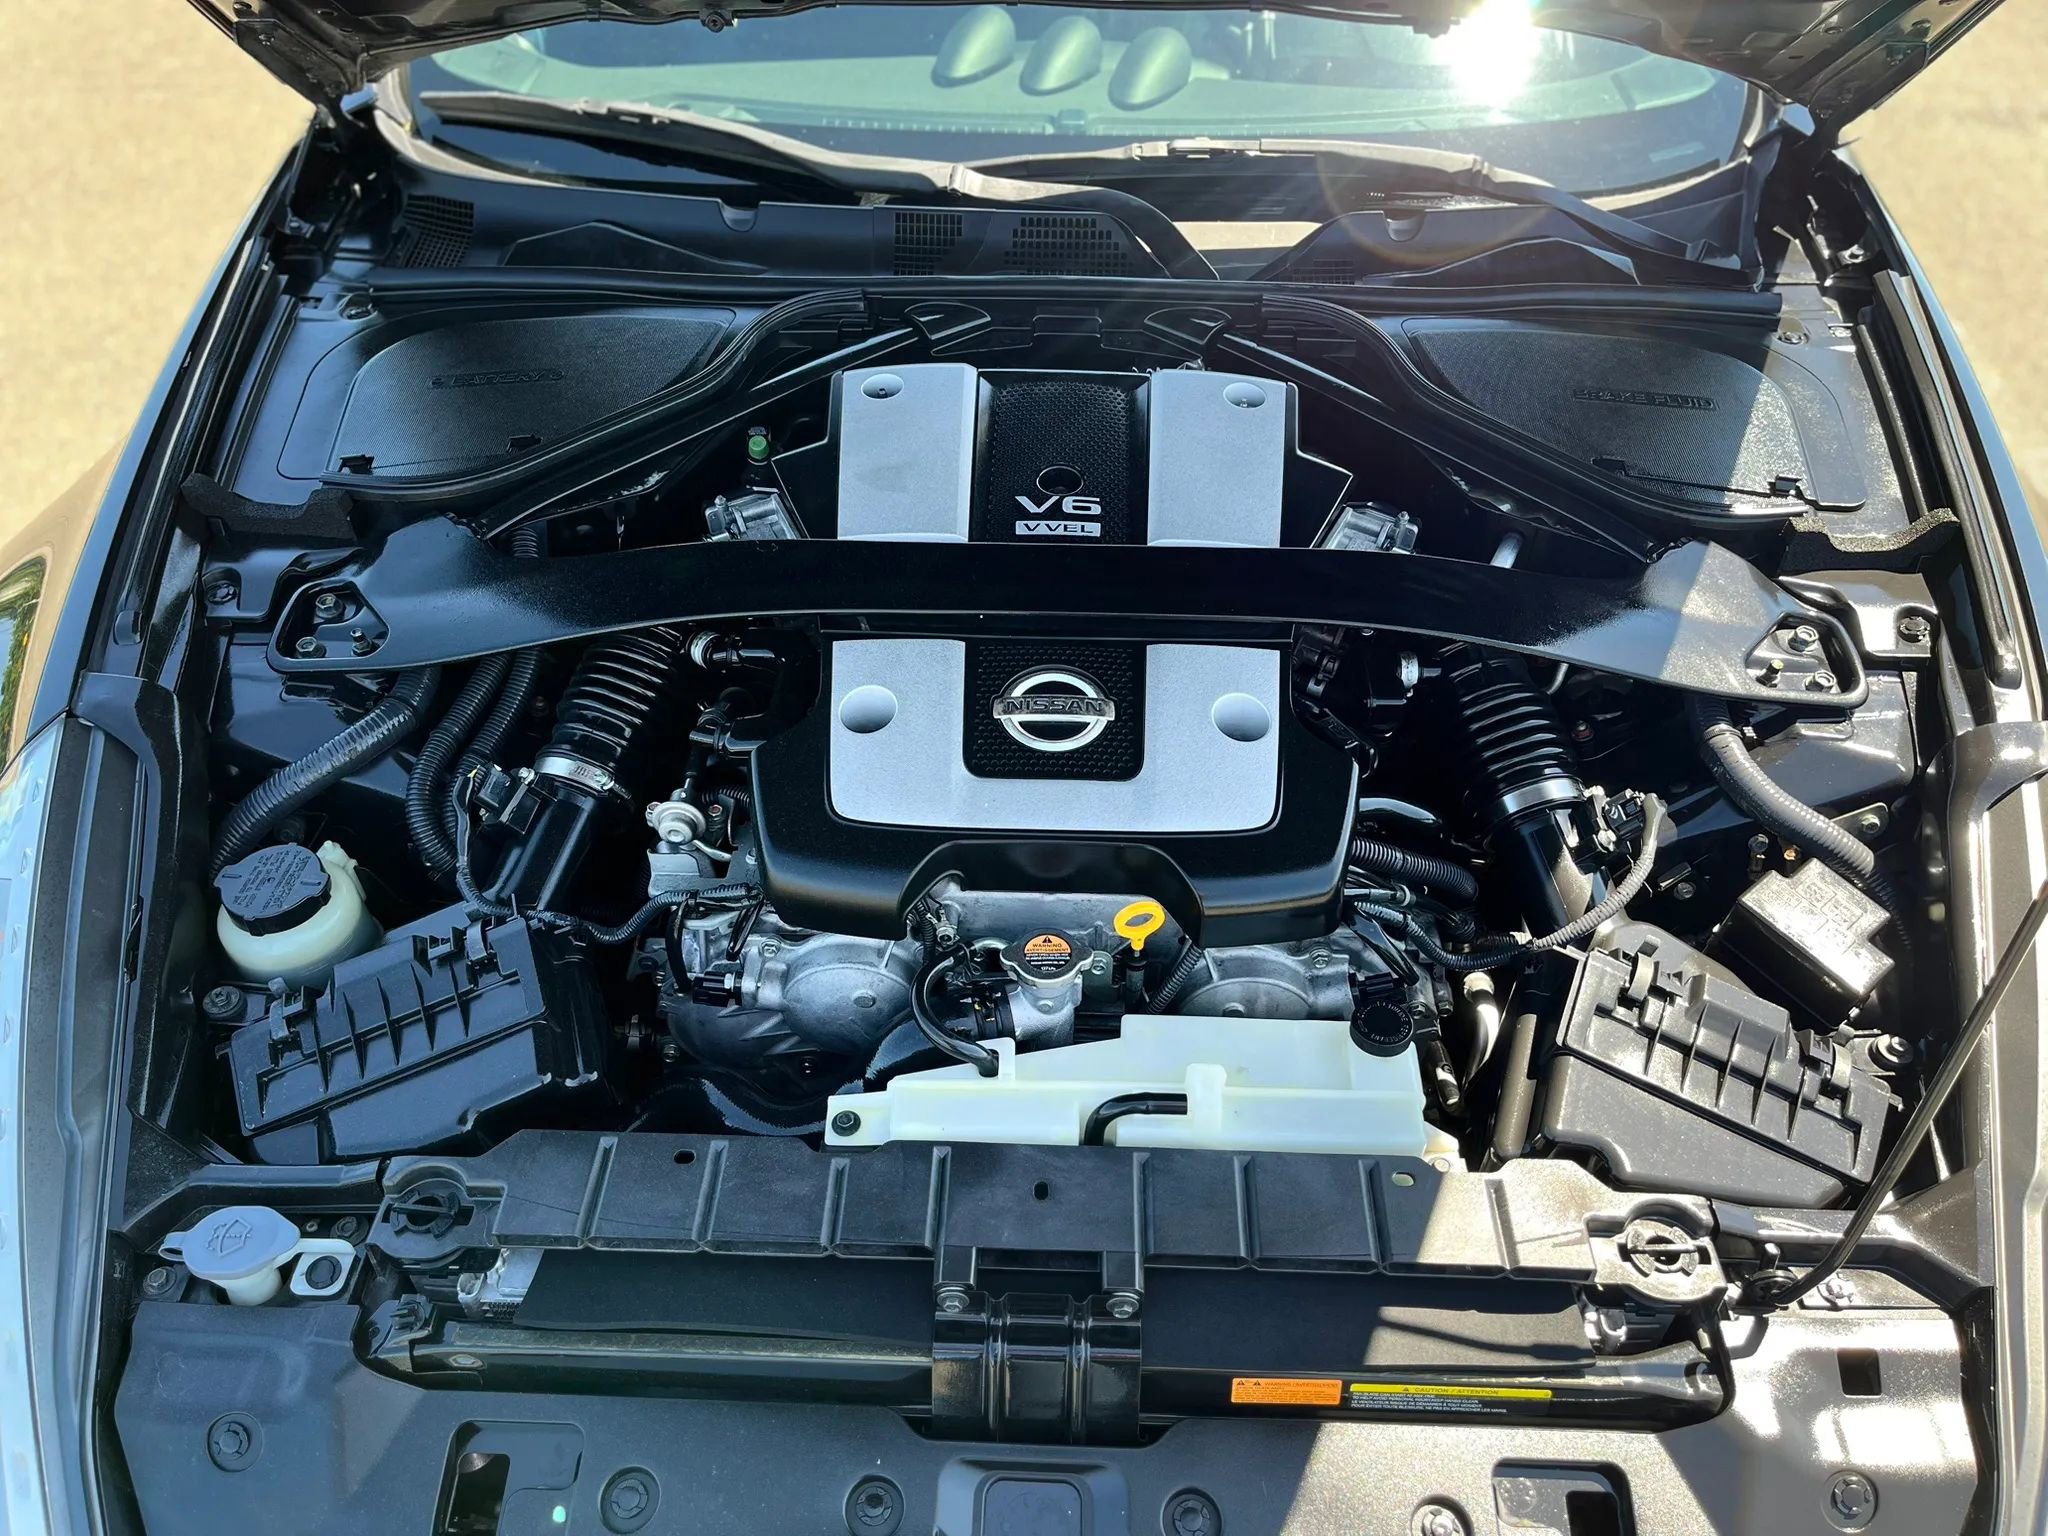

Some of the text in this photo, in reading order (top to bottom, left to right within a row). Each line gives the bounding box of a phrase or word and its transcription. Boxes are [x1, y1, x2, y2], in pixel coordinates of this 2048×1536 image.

[451, 369, 544, 386] BATTERY
[1575, 389, 1716, 410] BRAKE FLUID
[1014, 495, 1102, 515] V6
[1023, 522, 1094, 534] VVEL
[1006, 698, 1102, 713] NISSAN
[1456, 1388, 1499, 1396] ATTENTION
